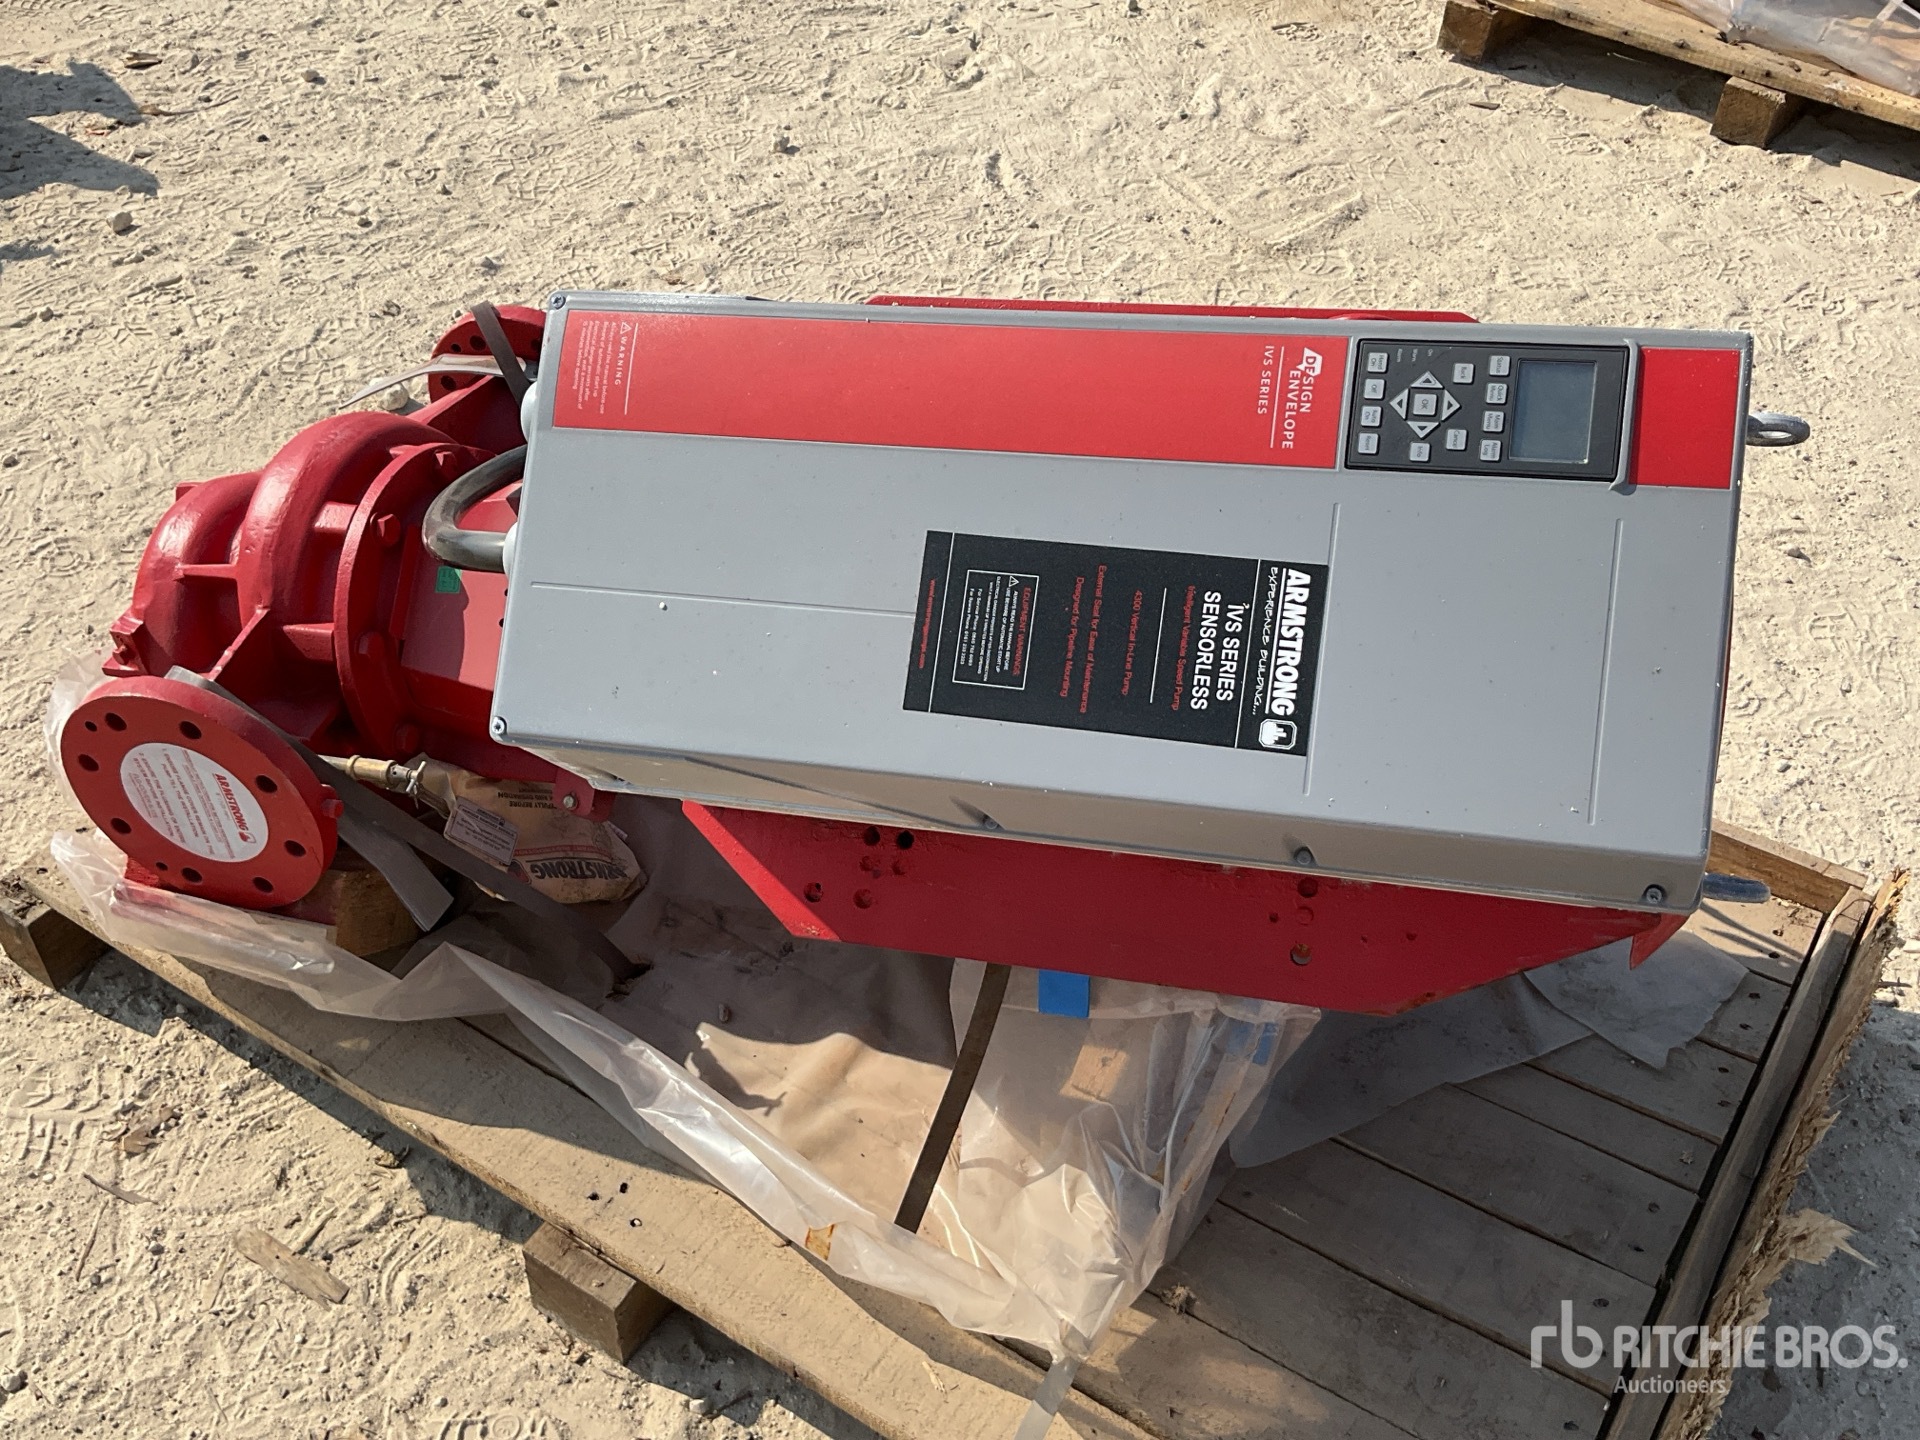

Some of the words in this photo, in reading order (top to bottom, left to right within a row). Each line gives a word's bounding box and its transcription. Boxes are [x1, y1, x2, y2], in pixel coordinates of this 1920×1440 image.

[614, 336, 627, 385] WARNING
[1262, 345, 1274, 365] IVS
[1370, 358, 1376, 366] On
[1427, 348, 1432, 356] On
[1495, 356, 1503, 373] Status
[1256, 370, 1271, 414] SERIES
[1298, 355, 1316, 412] DESIGN
[1496, 385, 1504, 400] Quick
[1280, 370, 1302, 448] ENVELOPE
[1364, 411, 1370, 419] On
[1421, 399, 1428, 409] OK
[1485, 413, 1493, 429] Menu
[1094, 564, 1106, 597] External
[1018, 587, 1030, 631] EQUIPMENT
[1070, 576, 1084, 614] Designed
[1092, 598, 1101, 616] Seal
[1132, 590, 1142, 610] 4300
[1182, 585, 1195, 623] Intelligent
[1259, 566, 1278, 645] EXPERIENCE
[1070, 615, 1078, 626] for
[1090, 618, 1098, 630] for
[1128, 612, 1139, 641] Vertical
[998, 624, 1006, 650] AUTOMATIC
[1064, 627, 1077, 658] Pipeline
[1087, 631, 1097, 650] Ease
[1179, 625, 1190, 656] Variable
[1189, 590, 1221, 710] SENSORLESS
[1270, 568, 1311, 716] ARMSTRONG
[1086, 652, 1094, 662] of
[1124, 642, 1135, 670] In-Line
[1215, 636, 1240, 701] SERIES
[1059, 660, 1072, 696] Mounting
[1120, 671, 1131, 695] Pump
[1174, 658, 1186, 684] Speed
[1079, 662, 1093, 713] Maintenance
[1170, 686, 1182, 710] Pump
[215, 773, 249, 831] ARMSTRONG
